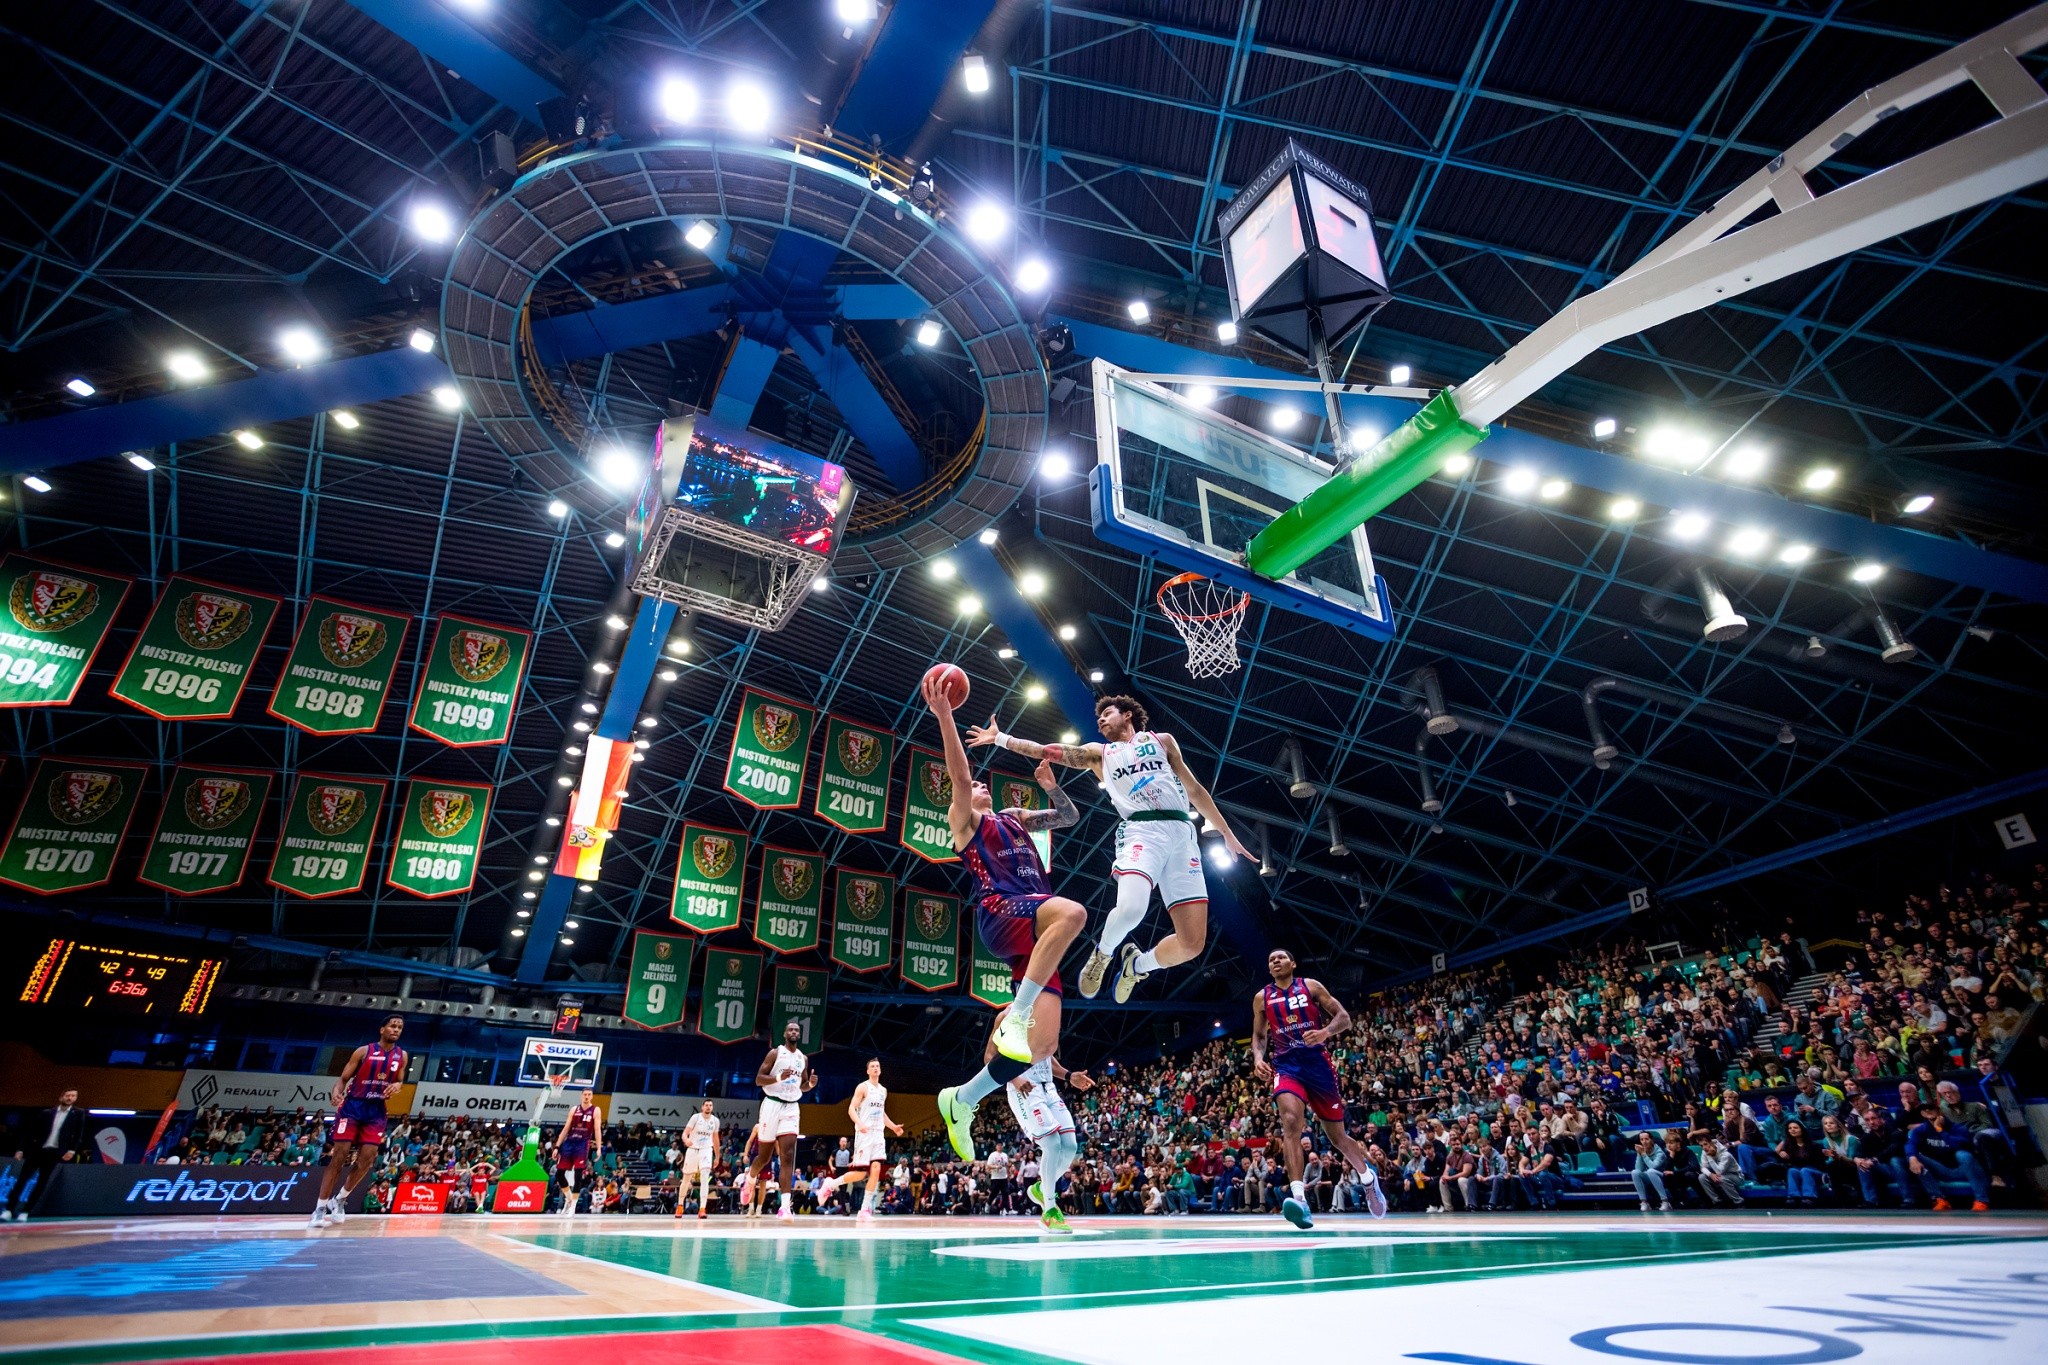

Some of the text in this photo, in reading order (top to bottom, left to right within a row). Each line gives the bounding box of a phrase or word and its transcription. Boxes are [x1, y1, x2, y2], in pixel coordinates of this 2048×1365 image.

[1298, 150, 1367, 200] AEROWATCH
[1223, 150, 1289, 227] AEROWATCH
[28, 638, 86, 660] POLSKI
[140, 645, 243, 675] MISTRZ POLSKI
[141, 667, 222, 703] 1996
[291, 664, 382, 692] MISTRZ POLSKI
[427, 680, 509, 704] MISTRZ POLSKI
[295, 685, 365, 718] 1998
[432, 700, 495, 730] 1999
[1134, 743, 1157, 758] 30
[737, 747, 800, 773] MISTRZ POLSKI
[737, 765, 791, 796] 2000
[825, 773, 885, 797] MISTRZ POLSKI
[829, 790, 875, 819] 2001
[909, 804, 938, 820] MISTRZ
[18, 827, 118, 844] MISTRZ POLSKI
[2005, 820, 2025, 842] E
[159, 832, 248, 848] MISTRZ POLSKI
[285, 837, 364, 854] MISTRZ POLSKI
[402, 839, 474, 855] MISTRZ POLSKI
[24, 847, 95, 873] 1970
[997, 848, 1013, 857] KING
[168, 851, 229, 876] 1977
[292, 855, 348, 880] 1979
[407, 856, 462, 880] 1980
[680, 879, 738, 895] MISTRZ POLSKI
[686, 895, 728, 918] 1981
[762, 901, 817, 916] MISTRZ POLSKI
[1633, 893, 1645, 909] D
[769, 916, 808, 938] 1987
[837, 922, 889, 936] MISTRZ POLSKI
[843, 936, 880, 957] 1991
[906, 940, 955, 955] MISTRZ POLSKI
[100, 961, 167, 980] 42 3 49
[647, 962, 675, 973] MACIEJ
[911, 955, 948, 977] 1992
[975, 959, 999, 970] MISTRZ
[1435, 956, 1443, 969] C
[642, 970, 677, 983] ZIELIŃSKI
[721, 979, 742, 988] ADAM
[646, 984, 667, 1014] 9
[717, 986, 745, 998] WÓJCIK
[779, 994, 821, 1006] MIECZYSŁAW
[785, 1003, 814, 1014] ŁOPATKA
[1288, 994, 1309, 1010] 22
[563, 1007, 580, 1017] 6:36
[714, 999, 745, 1030] 10
[556, 1016, 579, 1031] 21
[548, 1045, 592, 1056] SUZUKI
[390, 1061, 399, 1072] 3
[224, 1087, 280, 1097] RENAULT
[422, 1095, 527, 1112] Hala ORBITA
[618, 1106, 680, 1117] DACIA
[126, 1170, 300, 1211] rehasport
[401, 1203, 438, 1212] Bank Pekao
[507, 1200, 531, 1208] ORLEN
